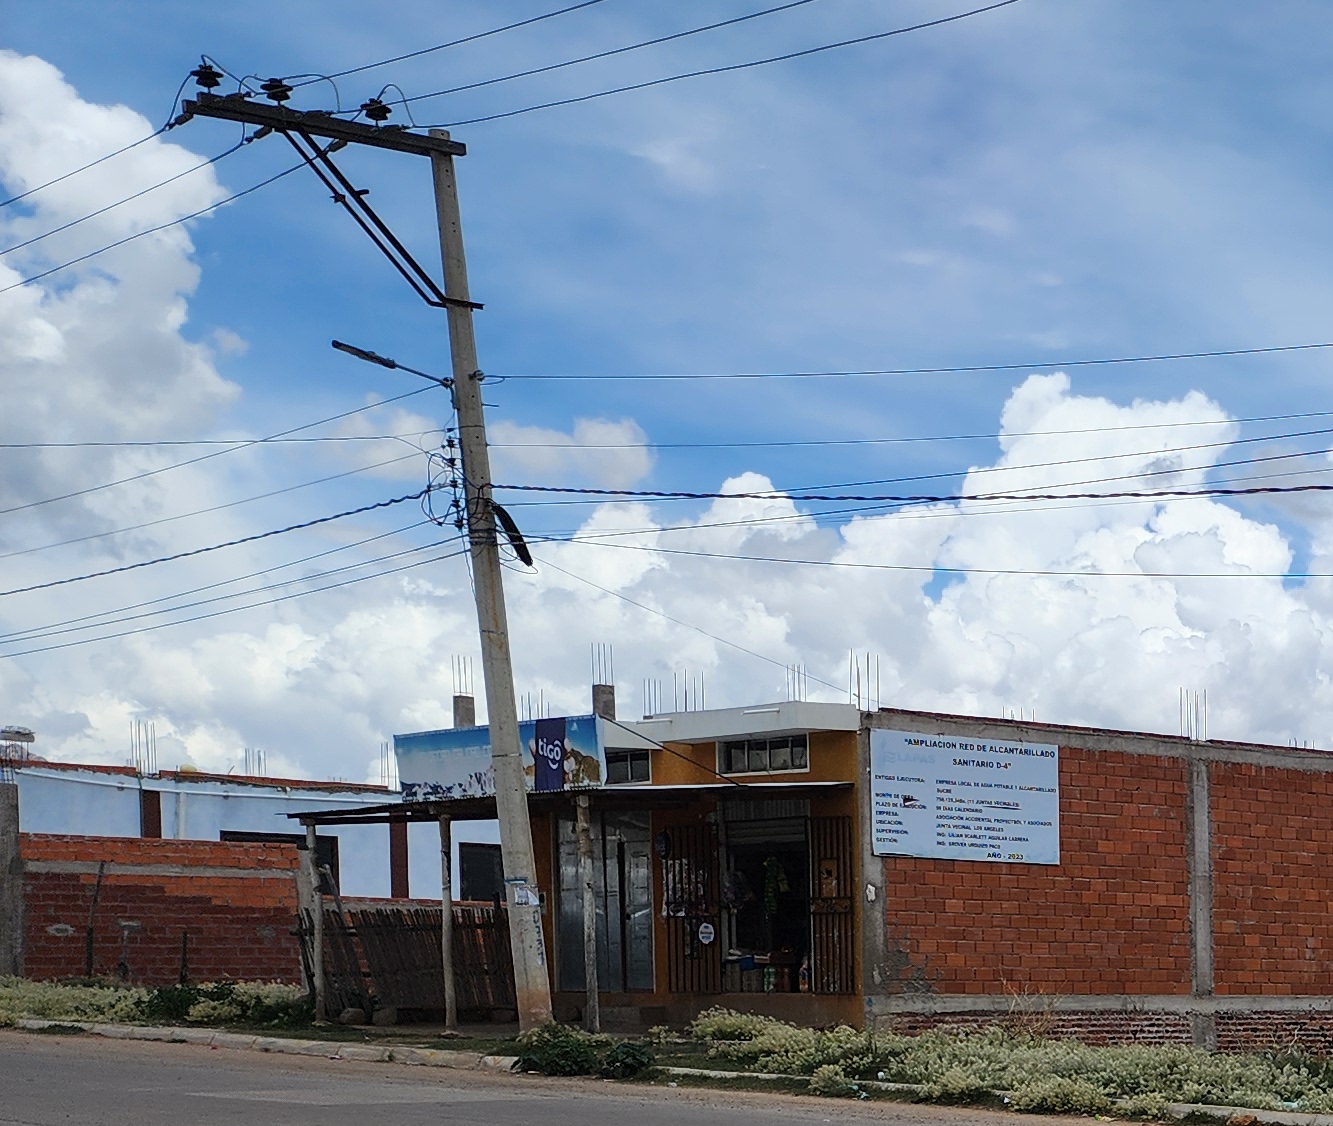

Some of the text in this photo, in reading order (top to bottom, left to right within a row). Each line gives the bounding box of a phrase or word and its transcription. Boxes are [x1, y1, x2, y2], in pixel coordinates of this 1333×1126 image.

[538, 737, 561, 770] tigo
[959, 743, 974, 751] RED
[977, 744, 987, 752] DE
[989, 746, 1055, 758] ALCANTARILLADO
[952, 759, 993, 769] SANITARIO
